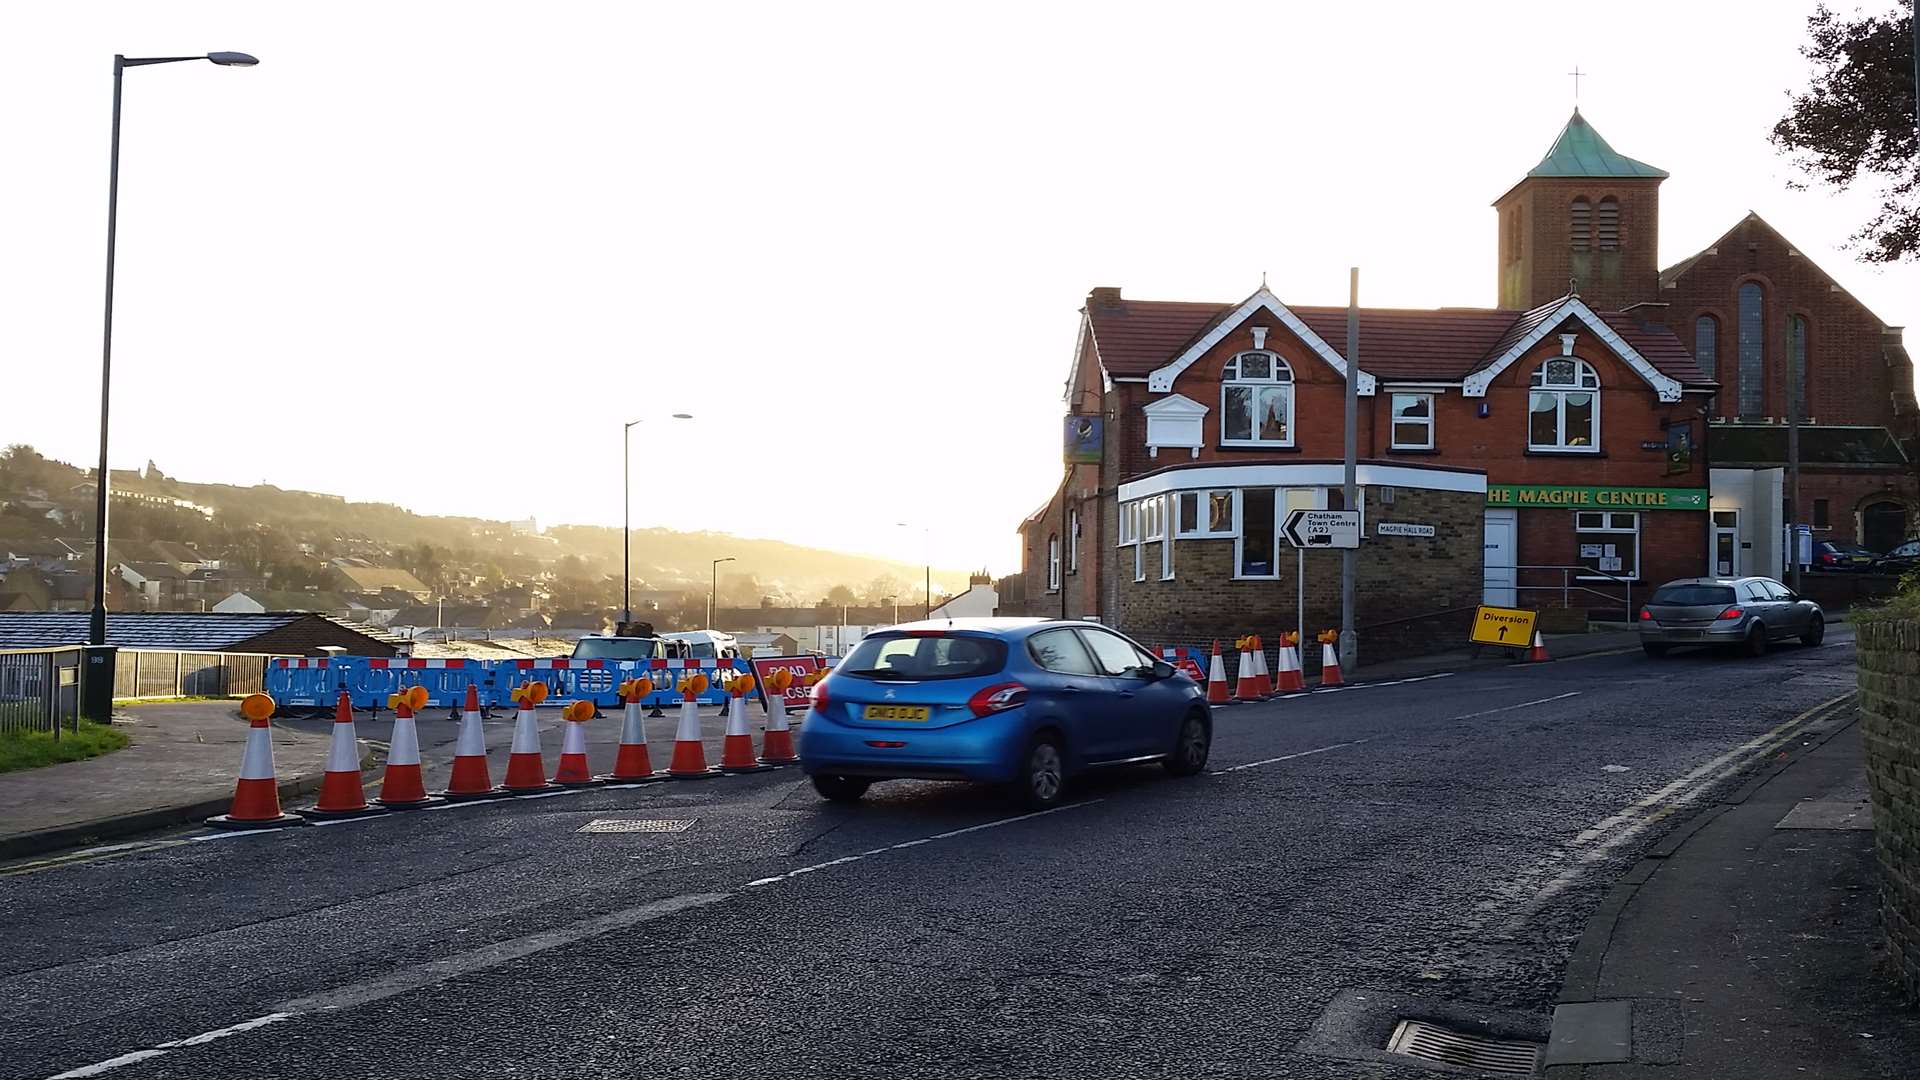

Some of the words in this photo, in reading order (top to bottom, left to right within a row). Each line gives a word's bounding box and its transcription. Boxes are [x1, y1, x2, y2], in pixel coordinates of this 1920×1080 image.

[1488, 489, 1511, 503] HE
[1518, 490, 1590, 505] MAGPIE
[1596, 491, 1667, 506] CENTRE
[1380, 525, 1402, 534] MAGPIE
[1403, 526, 1417, 534] HALL
[1418, 527, 1433, 535] ROAD
[1484, 613, 1528, 624] Diversion
[769, 665, 806, 677] RAD
